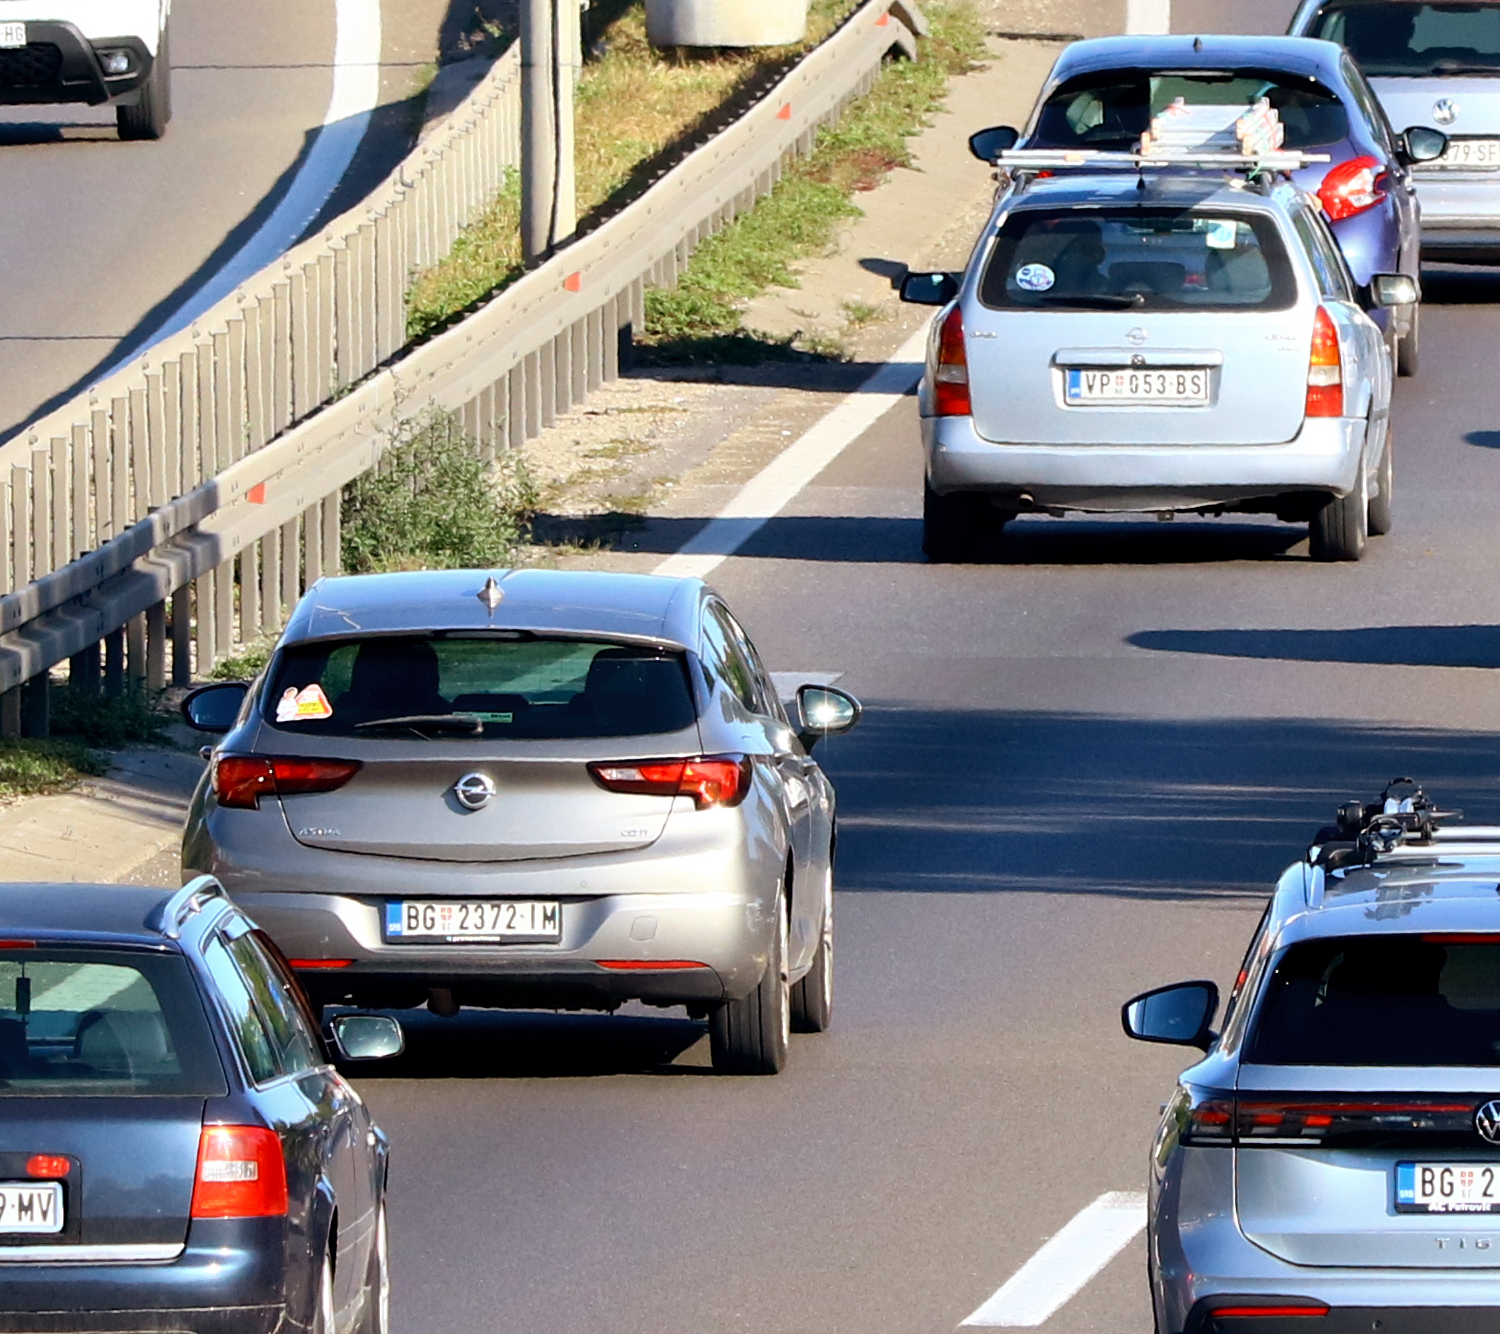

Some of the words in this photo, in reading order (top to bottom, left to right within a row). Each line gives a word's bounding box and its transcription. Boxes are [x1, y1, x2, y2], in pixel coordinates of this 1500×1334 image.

[1085, 373, 1110, 396] VP
[406, 904, 436, 931] BG
[1421, 1167, 1455, 1198] BG
[1428, 1202, 1446, 1212] AC
